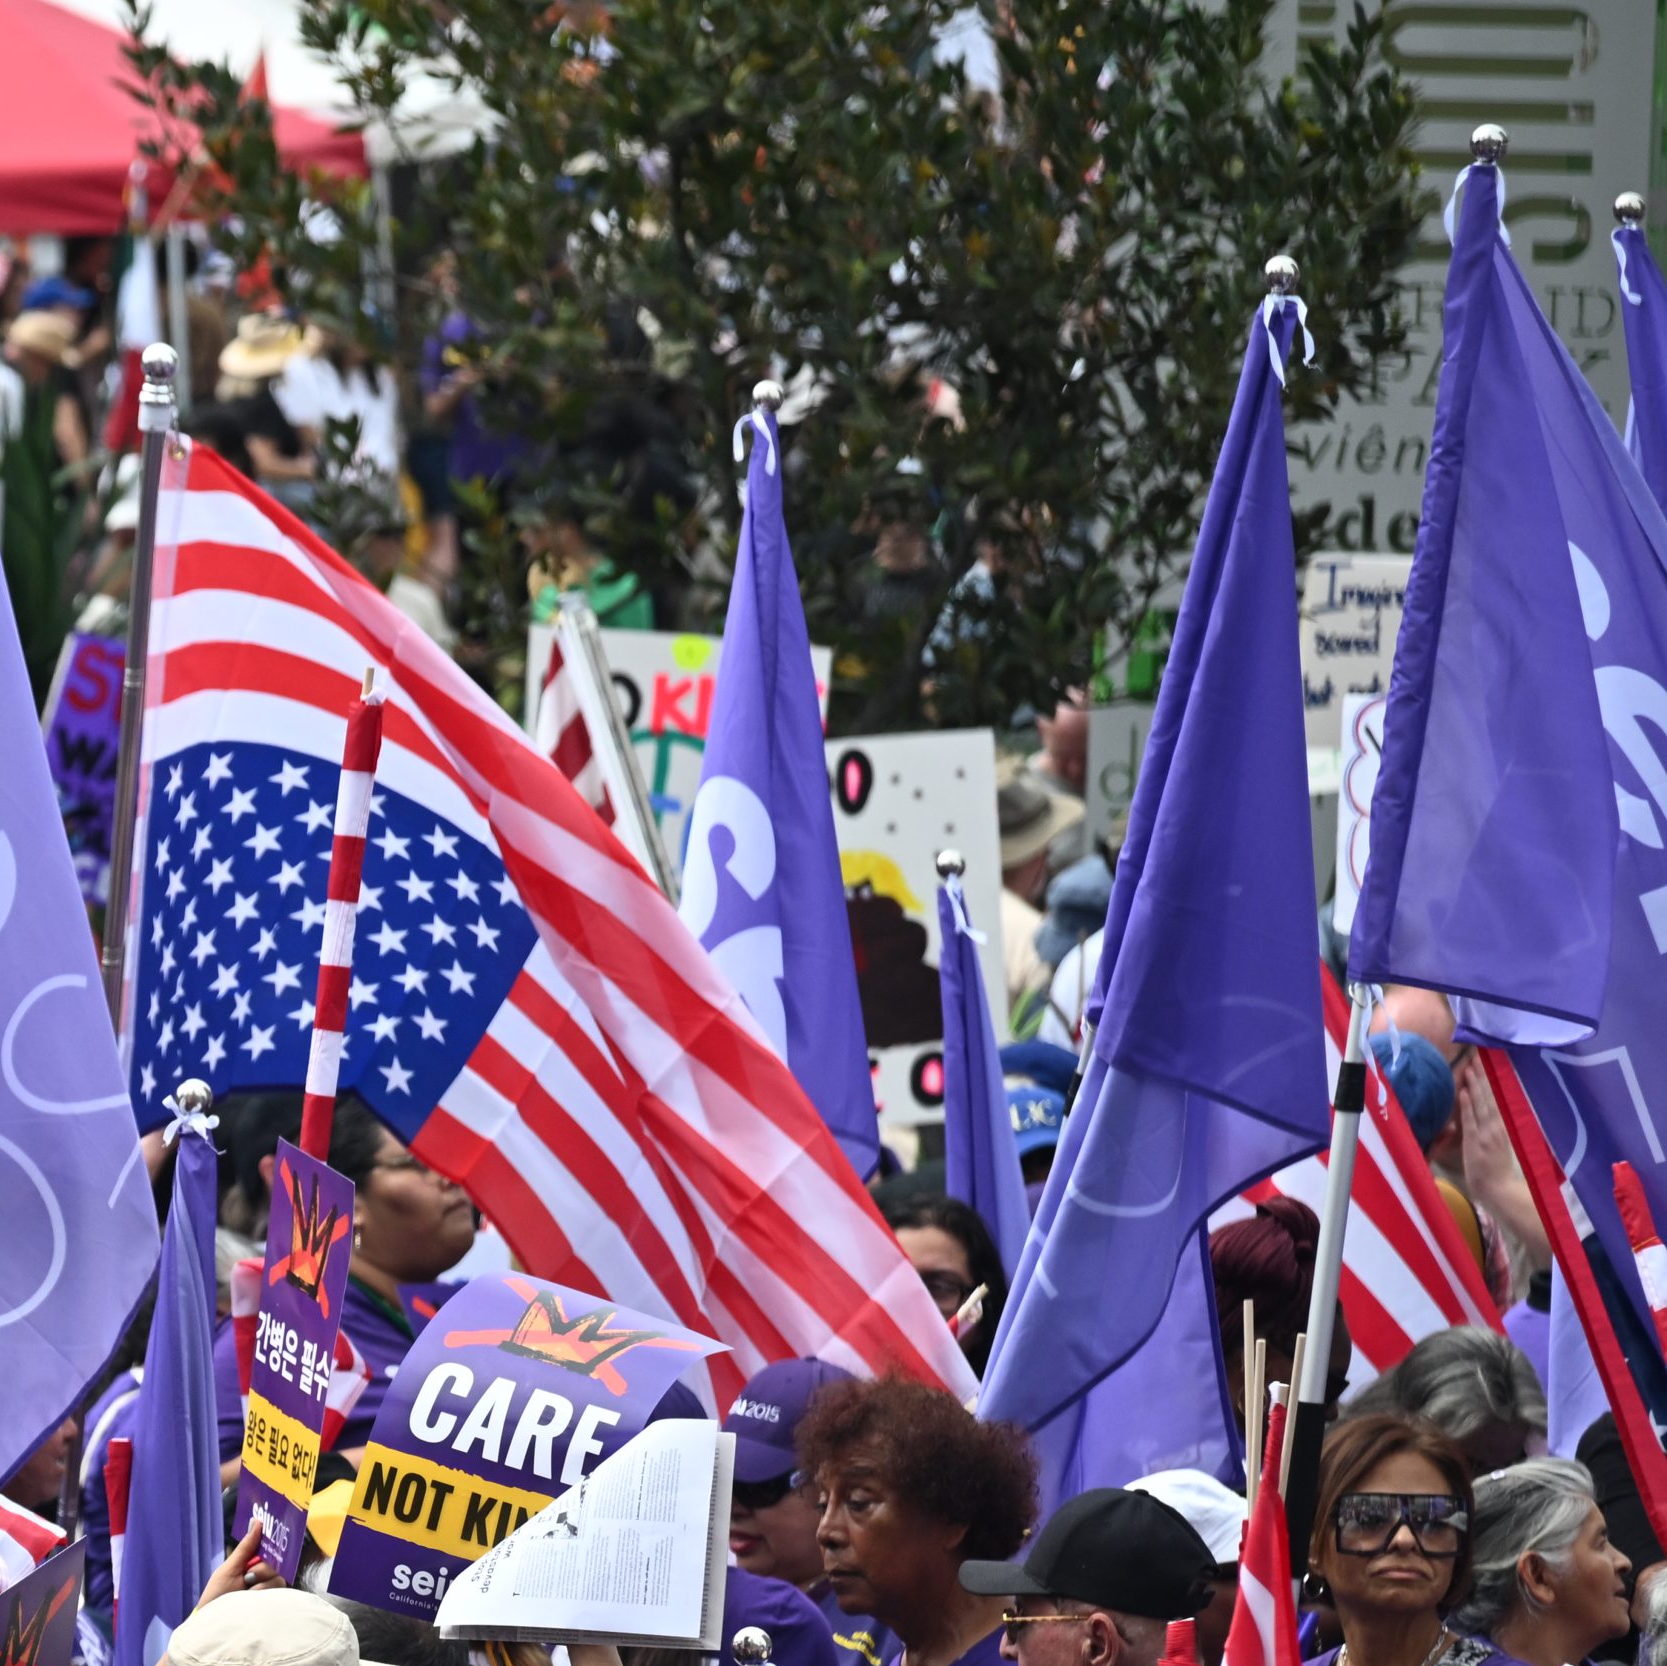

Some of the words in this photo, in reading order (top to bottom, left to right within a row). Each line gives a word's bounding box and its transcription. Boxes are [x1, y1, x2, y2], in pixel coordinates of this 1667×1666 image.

[255, 1311, 299, 1383] 간병은
[299, 1340, 331, 1402] 필수
[268, 1428, 290, 1468] 필요
[292, 1441, 317, 1490] 없다!
[408, 1362, 621, 1487] CARE
[361, 1461, 455, 1533] NOT
[391, 1563, 452, 1598] sei
